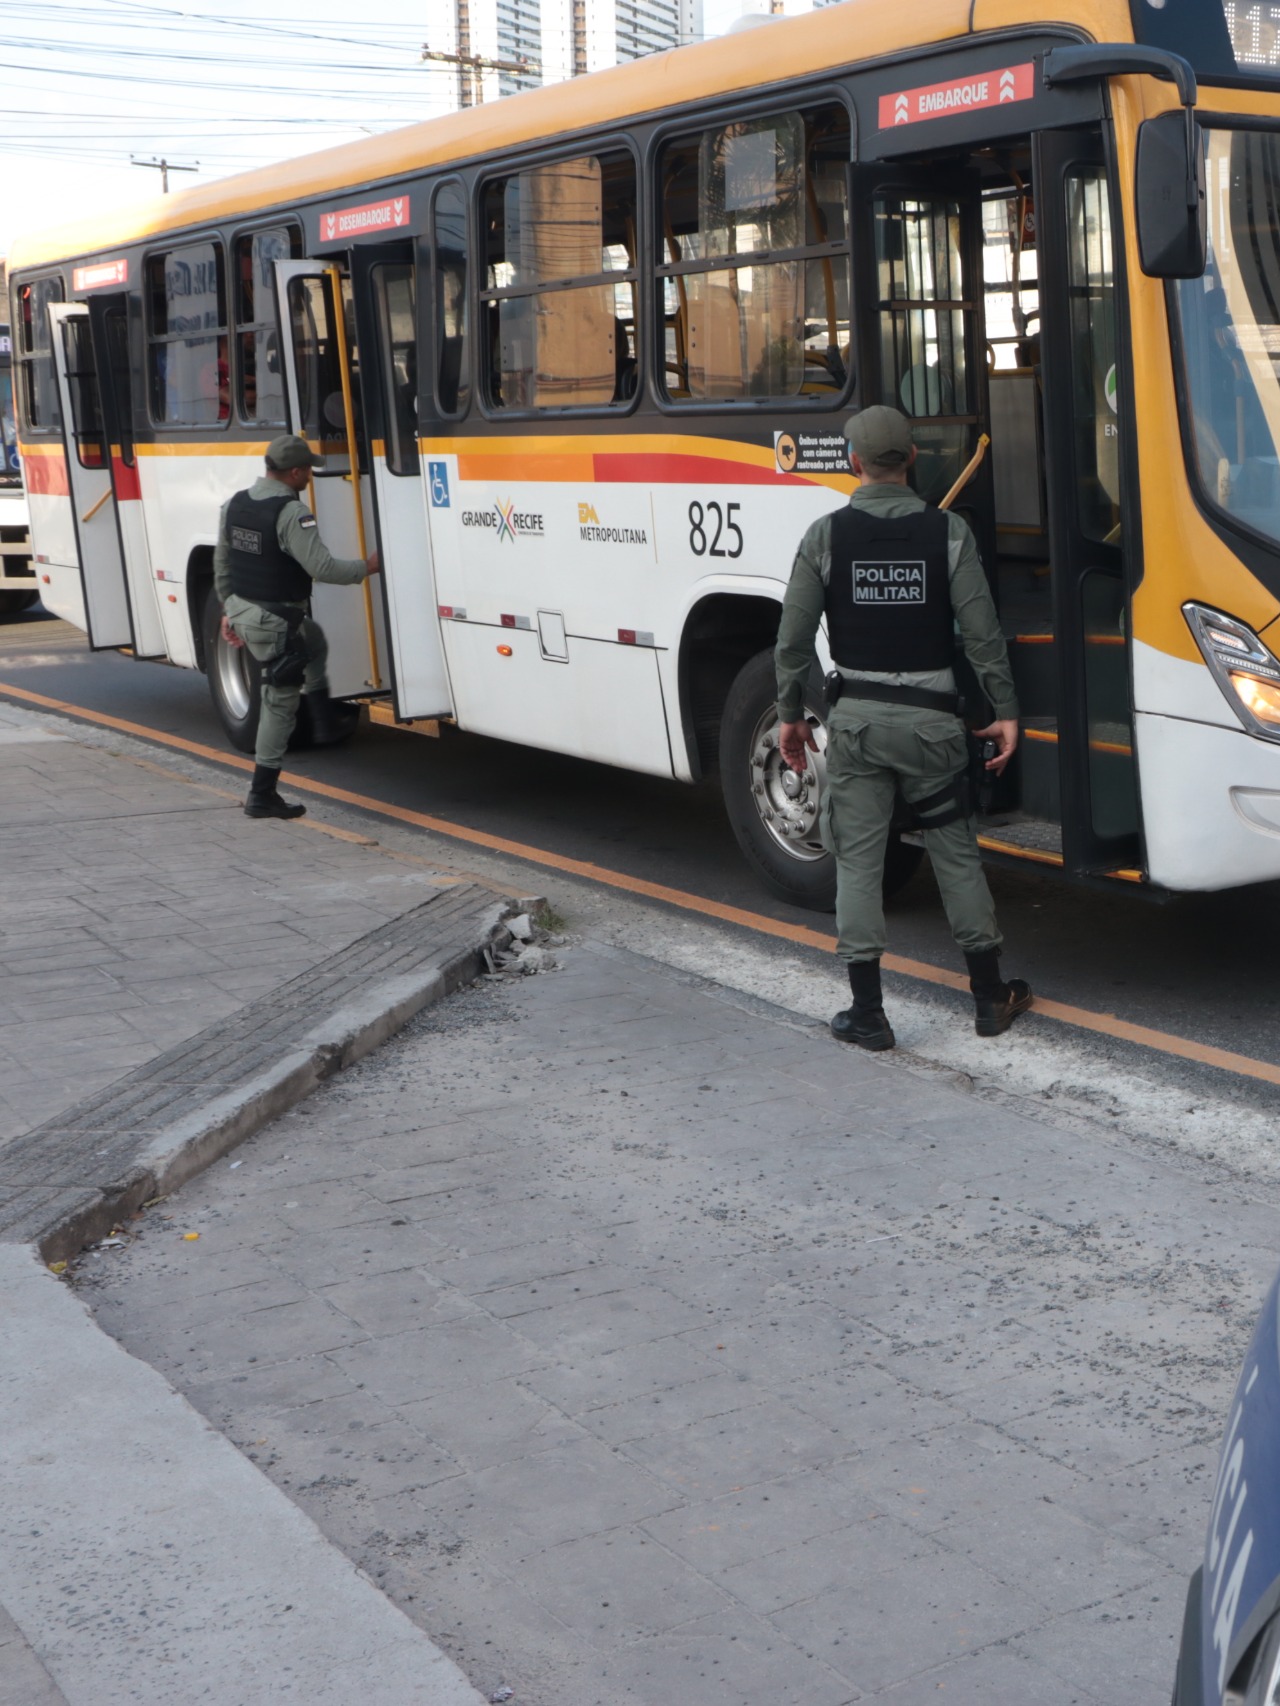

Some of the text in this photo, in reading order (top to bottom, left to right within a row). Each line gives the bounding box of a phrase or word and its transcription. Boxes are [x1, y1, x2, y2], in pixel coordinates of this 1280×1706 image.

[918, 81, 989, 114] EMBARQUE
[339, 206, 391, 231] DESEMBARQUE
[462, 512, 544, 530] GRANDE RECIFE
[688, 500, 744, 559] 825
[580, 527, 647, 545] METROPOLITANA
[855, 565, 922, 582] POLÍCIA
[856, 586, 921, 600] MILITAR
